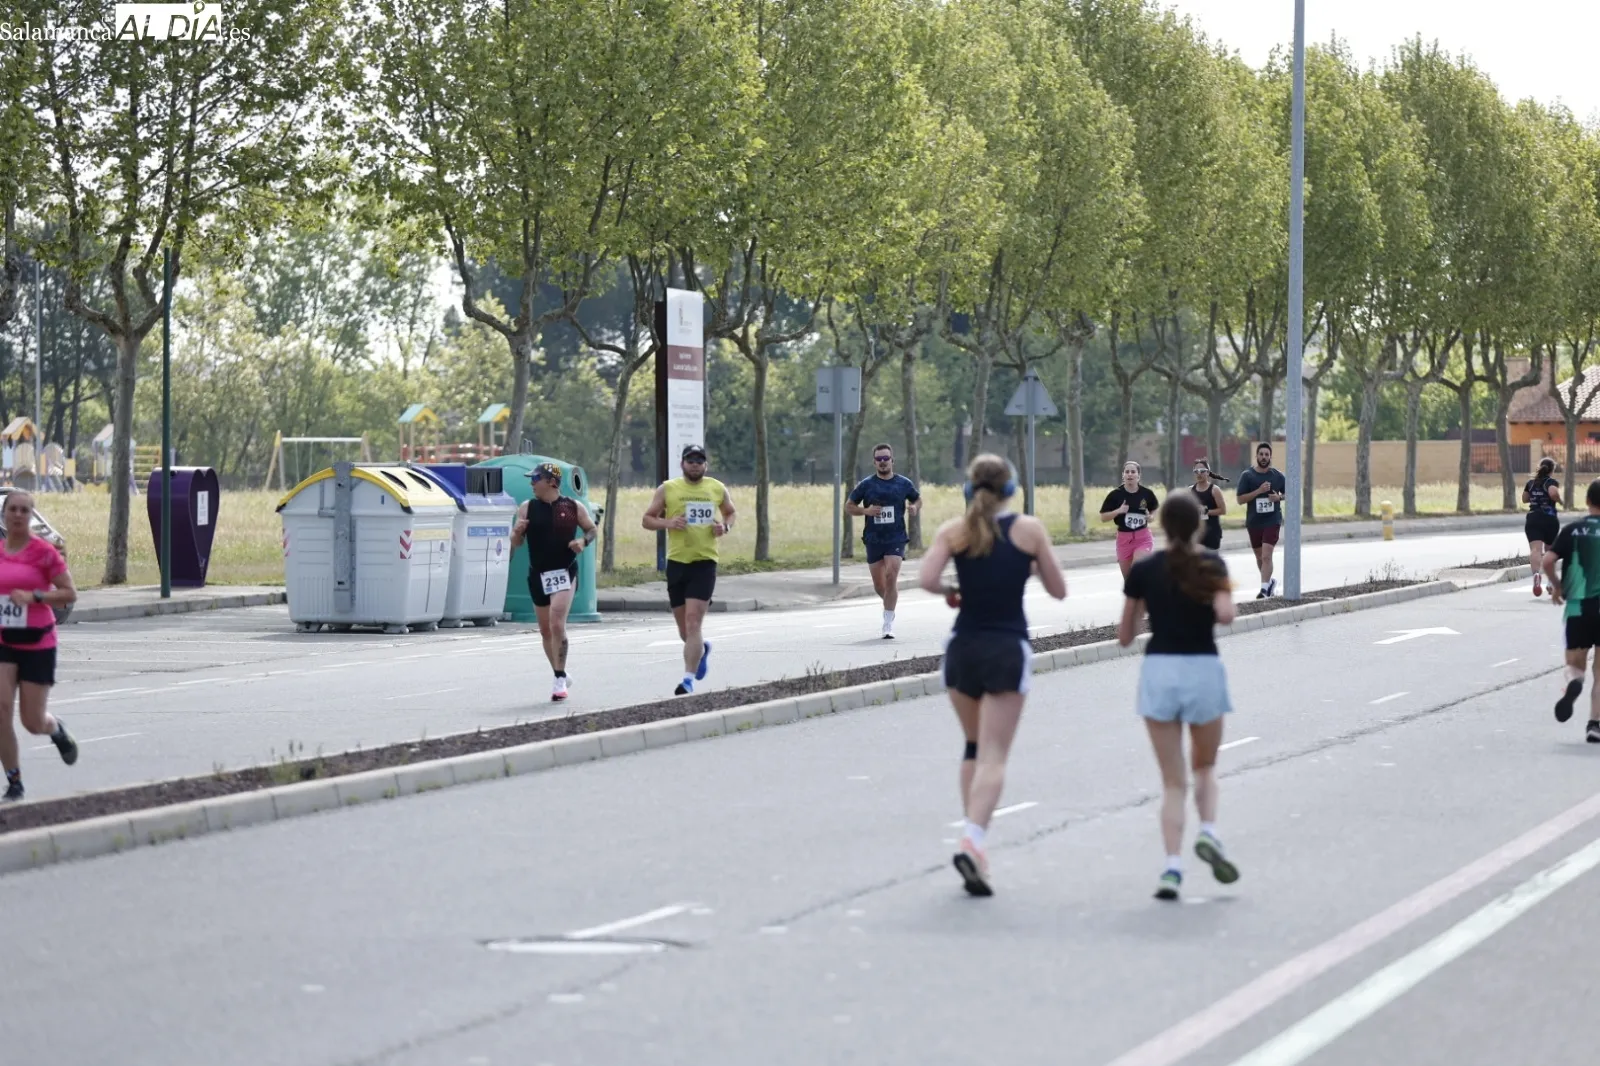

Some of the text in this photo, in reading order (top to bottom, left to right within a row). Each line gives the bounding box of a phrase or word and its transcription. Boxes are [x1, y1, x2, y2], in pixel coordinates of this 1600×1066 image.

[690, 508, 712, 518] 330
[1127, 517, 1144, 526] 209
[545, 575, 567, 587] 235
